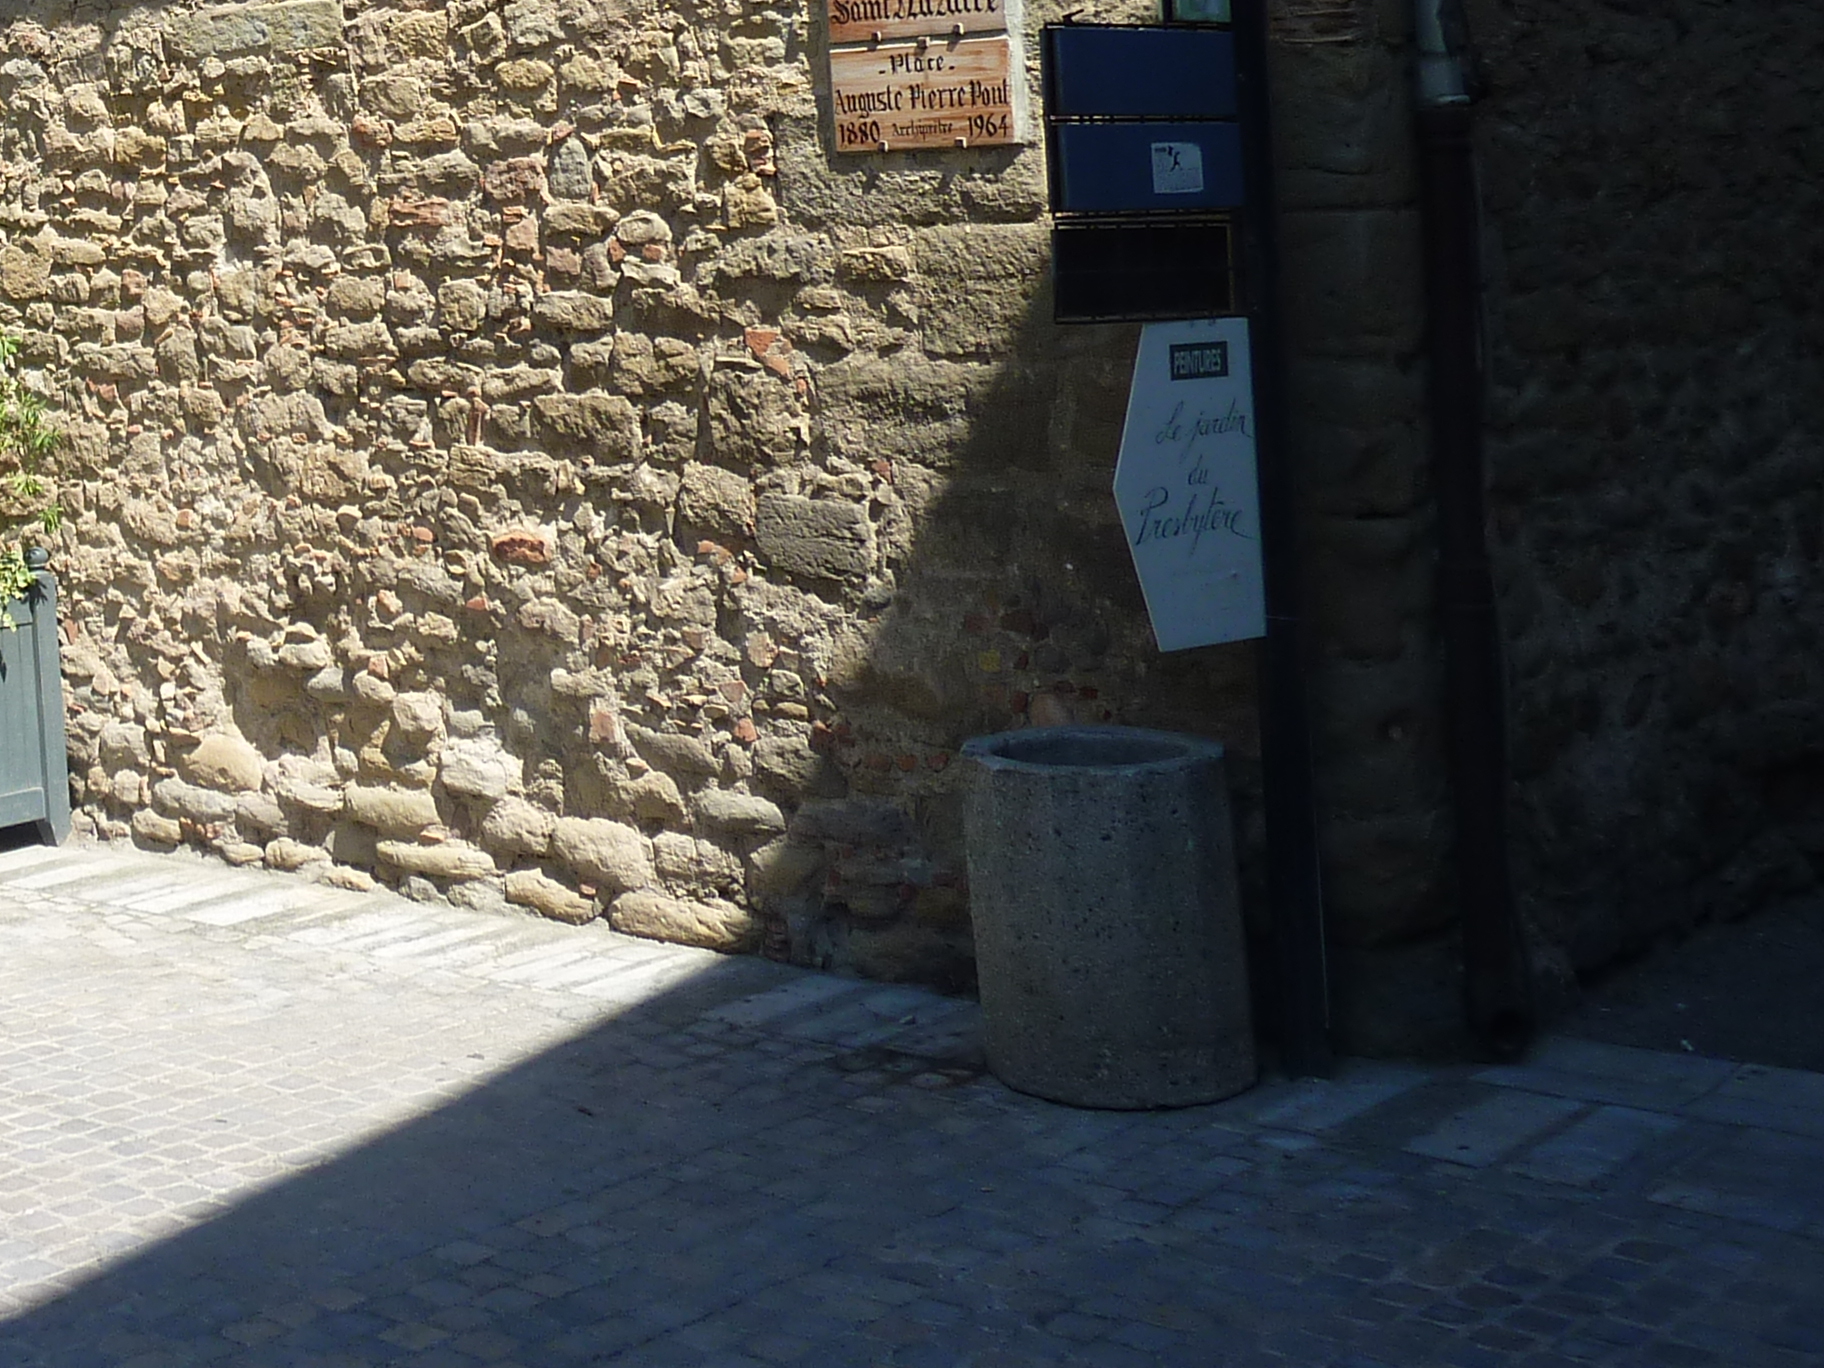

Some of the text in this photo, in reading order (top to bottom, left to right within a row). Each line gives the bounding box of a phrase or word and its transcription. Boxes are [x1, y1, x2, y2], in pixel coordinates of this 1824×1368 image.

[834, 84, 903, 119] Auguste
[909, 82, 966, 110] Pierre
[838, 120, 881, 145] 1880
[968, 112, 1010, 138] 1964
[1174, 348, 1222, 374] PEINTURES
[1156, 397, 1255, 464] Le jardin
[1187, 454, 1209, 486] du
